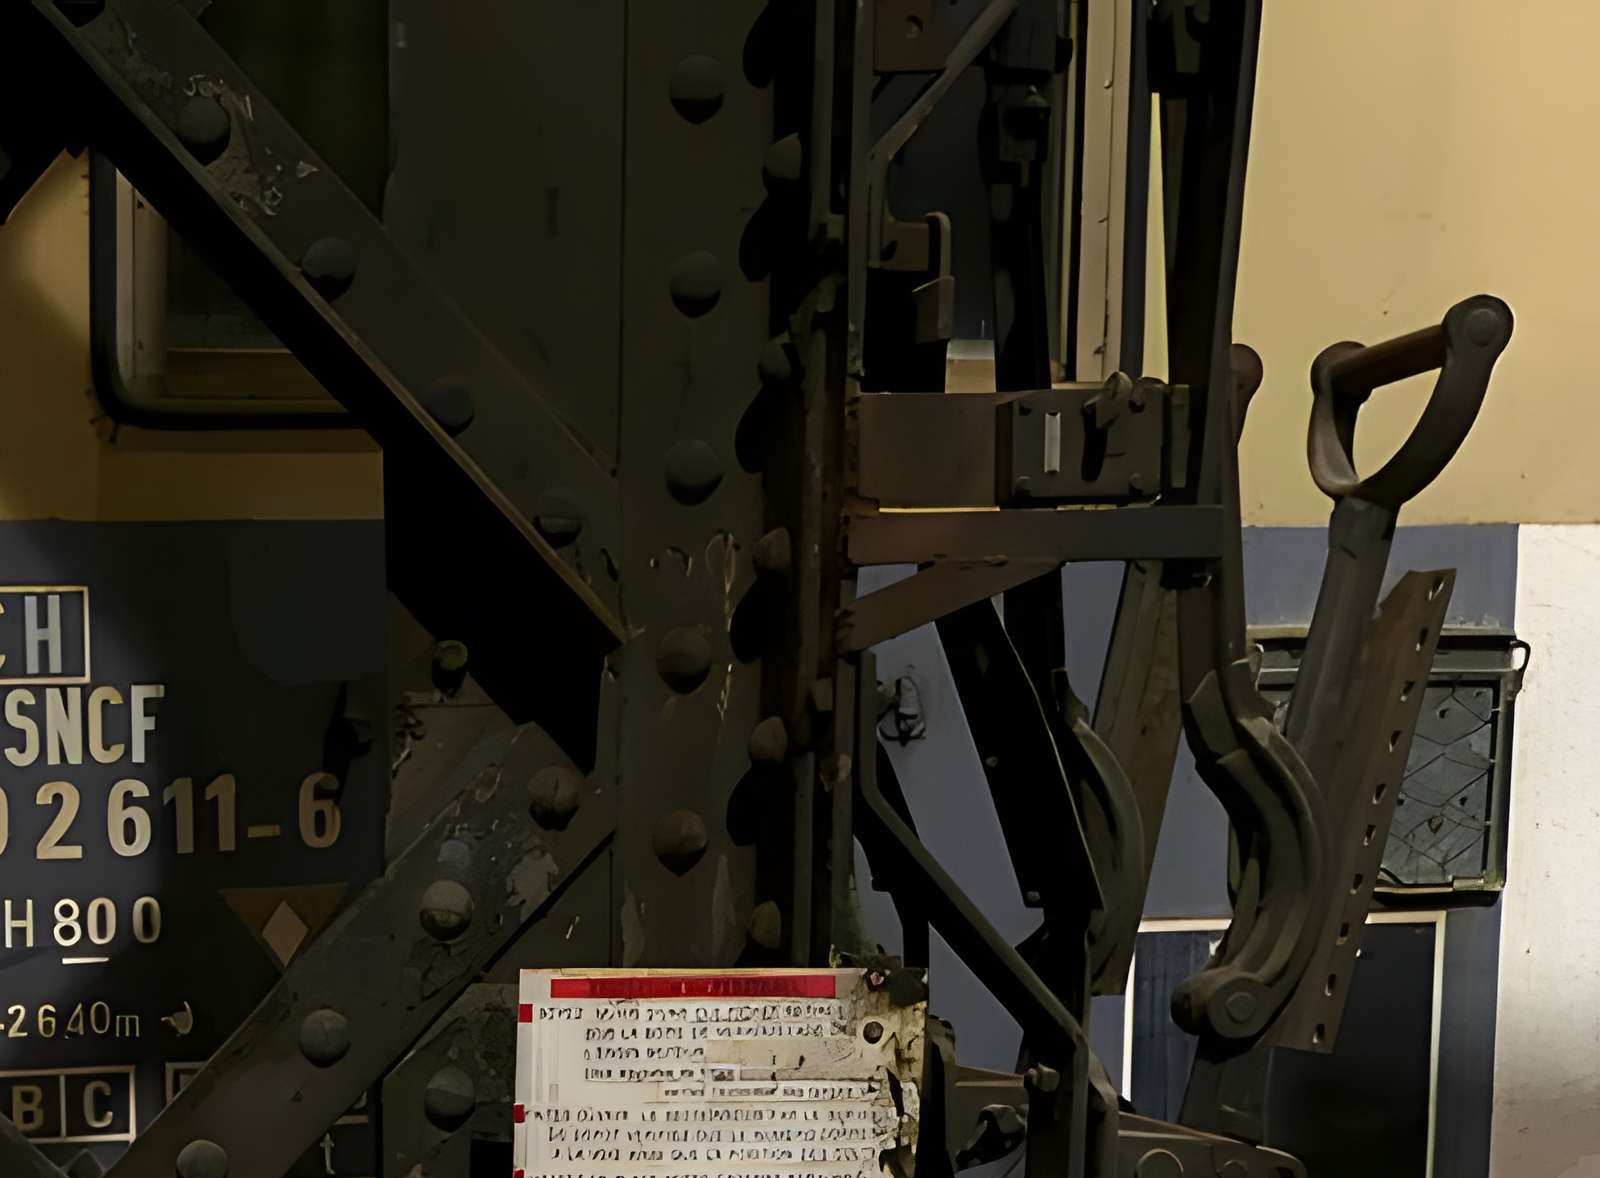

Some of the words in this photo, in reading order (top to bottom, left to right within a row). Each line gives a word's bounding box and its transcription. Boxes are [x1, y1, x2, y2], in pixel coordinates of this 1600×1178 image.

[4, 684, 166, 767] SNCF
[11, 1083, 46, 1133] B
[82, 1078, 115, 1129] C
